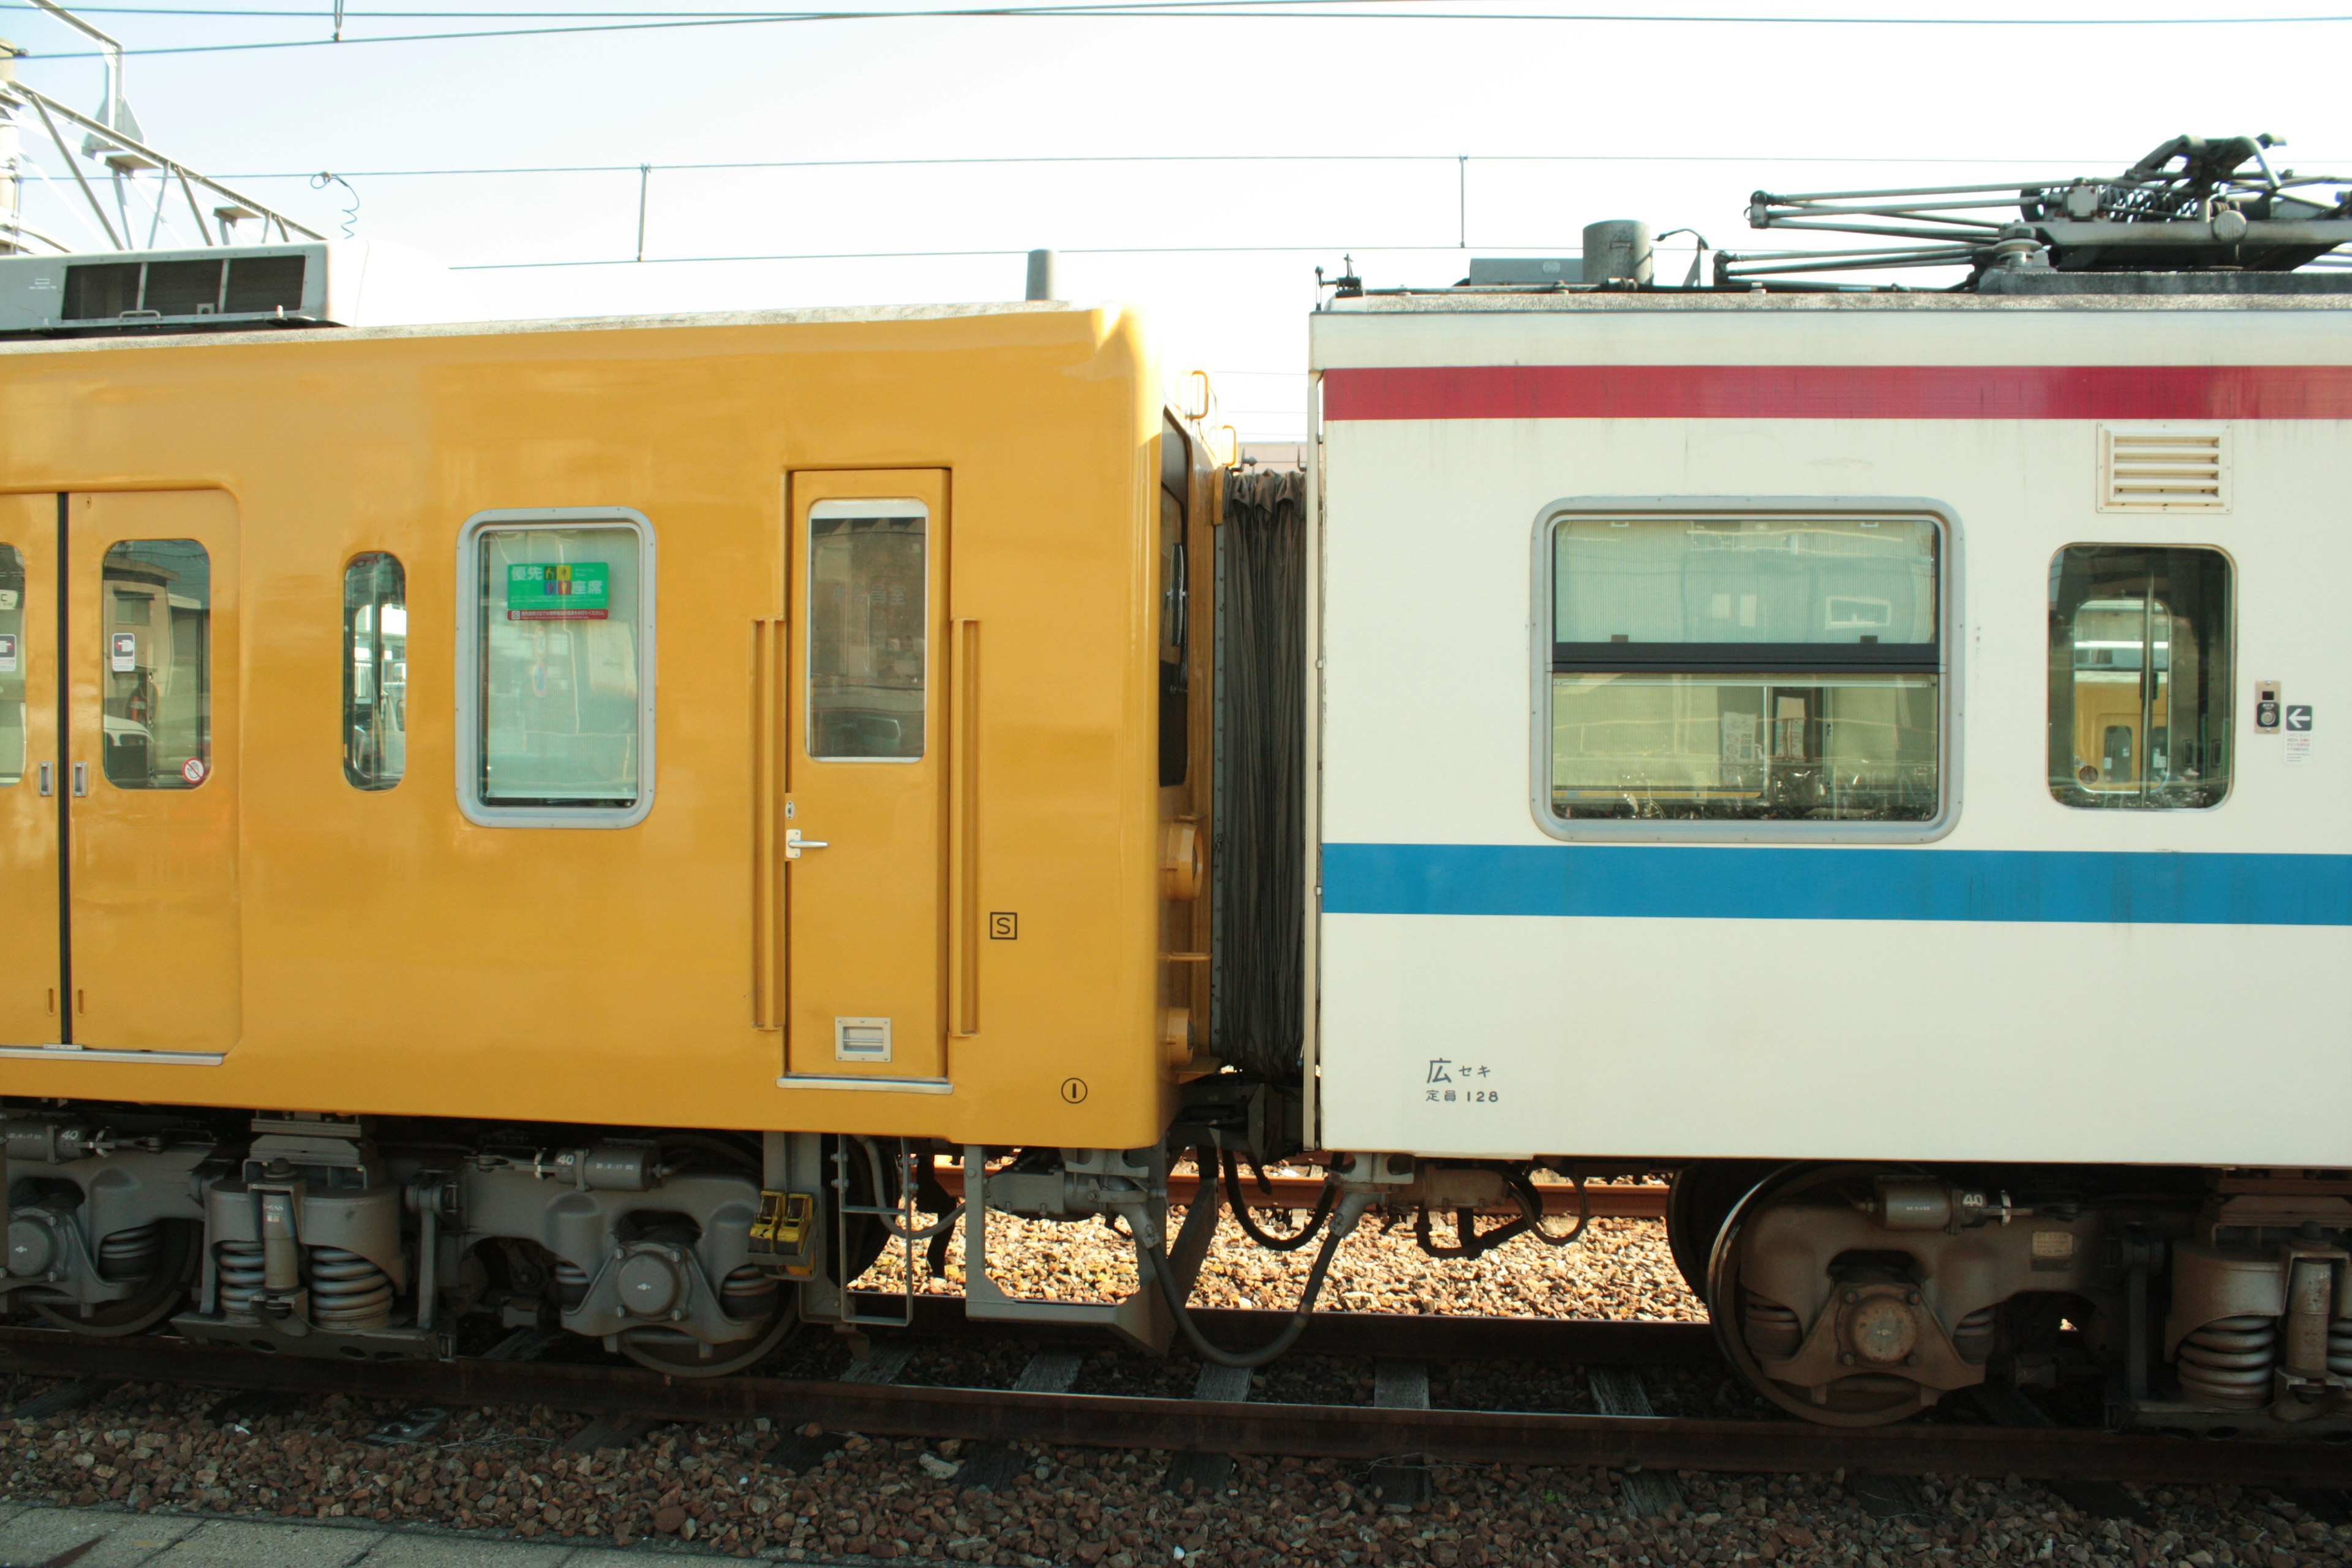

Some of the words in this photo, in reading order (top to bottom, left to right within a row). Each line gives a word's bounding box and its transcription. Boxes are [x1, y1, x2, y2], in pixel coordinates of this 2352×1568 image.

[511, 566, 543, 581] 優先
[571, 580, 603, 594] 座席
[996, 917, 1011, 935] S
[1427, 1057, 1491, 1084] 広セキ
[1425, 1090, 1457, 1102] 定員
[1467, 1091, 1499, 1102] 128
[61, 1130, 79, 1140] 40
[557, 1155, 575, 1164] 40
[1962, 1194, 1984, 1207] 40
